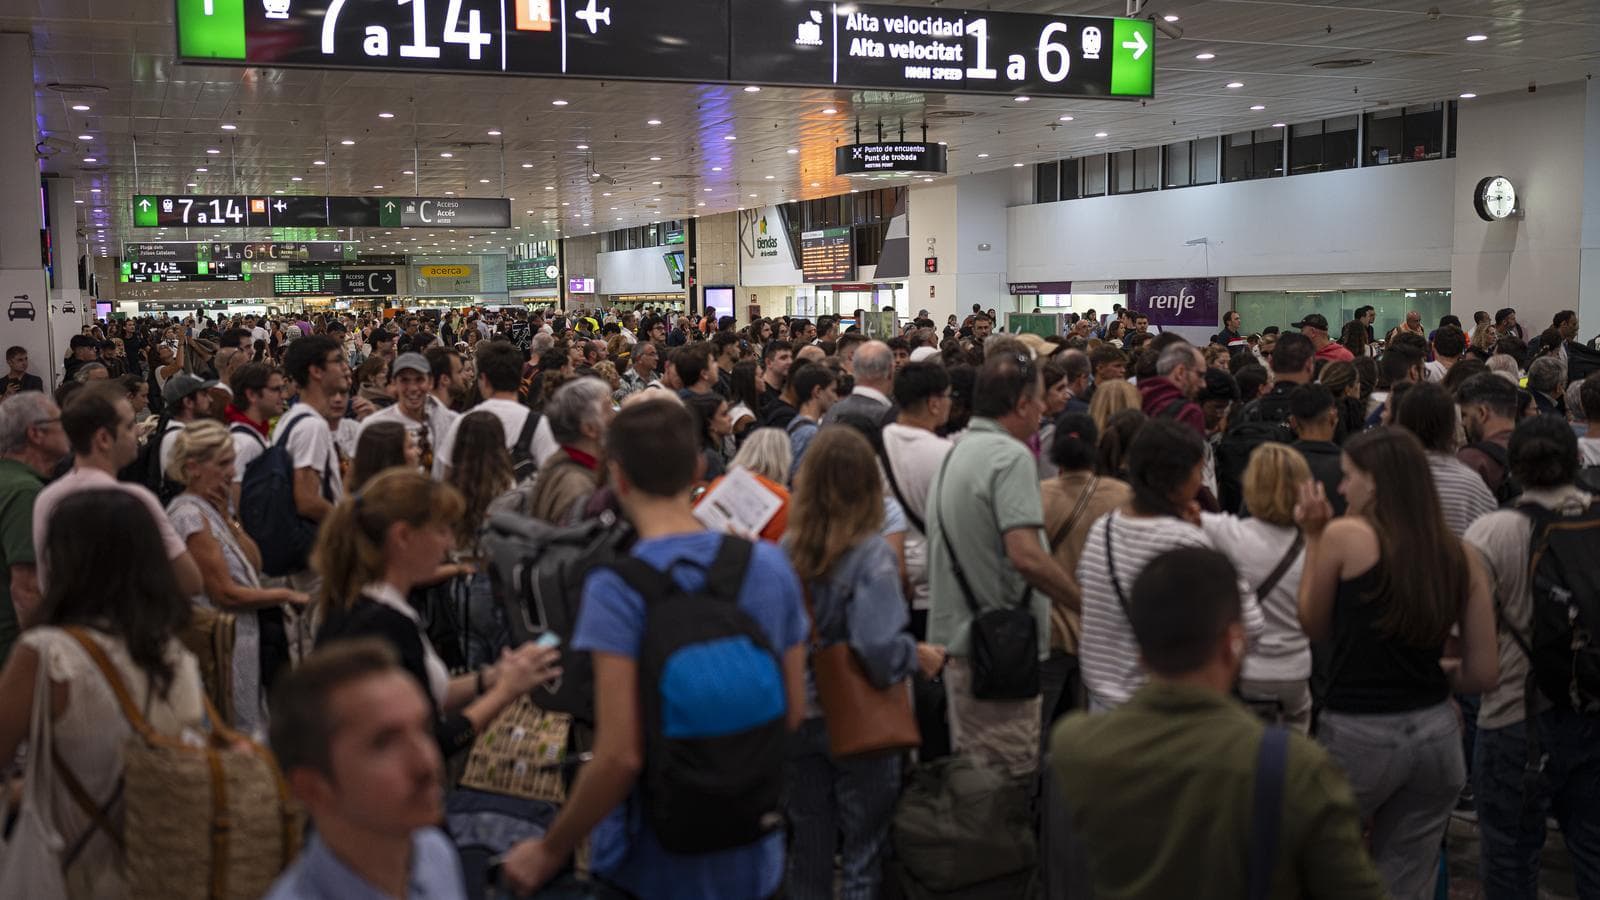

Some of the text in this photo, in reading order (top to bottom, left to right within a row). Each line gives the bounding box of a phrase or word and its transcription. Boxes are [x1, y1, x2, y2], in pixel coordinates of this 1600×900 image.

[321, 0, 492, 60] 7 a 14
[846, 12, 963, 37] Alta velocidad
[850, 38, 963, 61] Alta velocitat
[965, 18, 1071, 83] 1 a 6
[905, 66, 963, 80] HIGH SPEED
[178, 199, 243, 224] 7 a 14
[420, 201, 432, 223] C
[224, 244, 234, 259] 1
[244, 244, 253, 259] 6
[269, 244, 278, 259] C
[757, 236, 777, 249] tiendas
[139, 262, 147, 273] 7
[153, 262, 169, 273] 14
[430, 267, 462, 275] acerca
[368, 272, 379, 292] C
[1149, 287, 1196, 316] renfe
